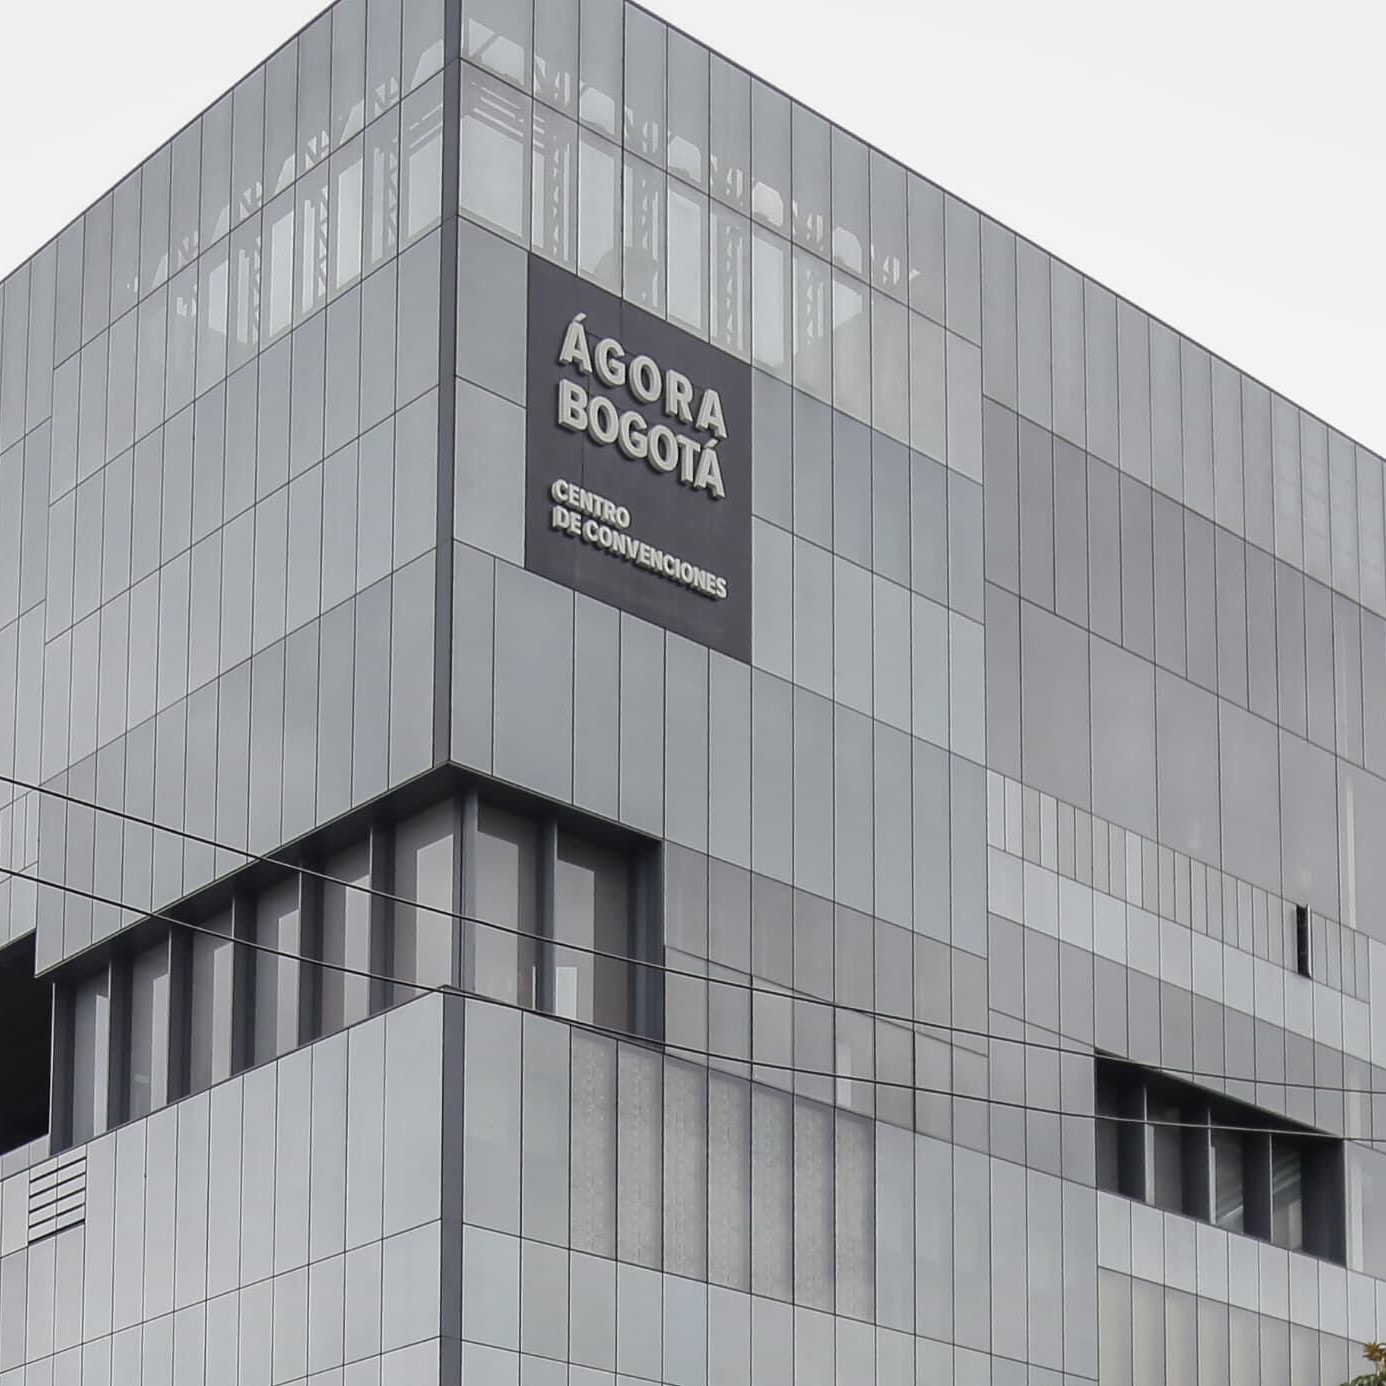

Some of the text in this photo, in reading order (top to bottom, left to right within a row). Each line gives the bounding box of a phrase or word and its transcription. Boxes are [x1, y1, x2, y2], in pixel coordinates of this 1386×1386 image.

[558, 313, 727, 439] ÁGORA
[558, 378, 726, 498] BOGOTÁ
[551, 479, 631, 529] CENTRO
[552, 505, 727, 599] DE CONVENCIONES
